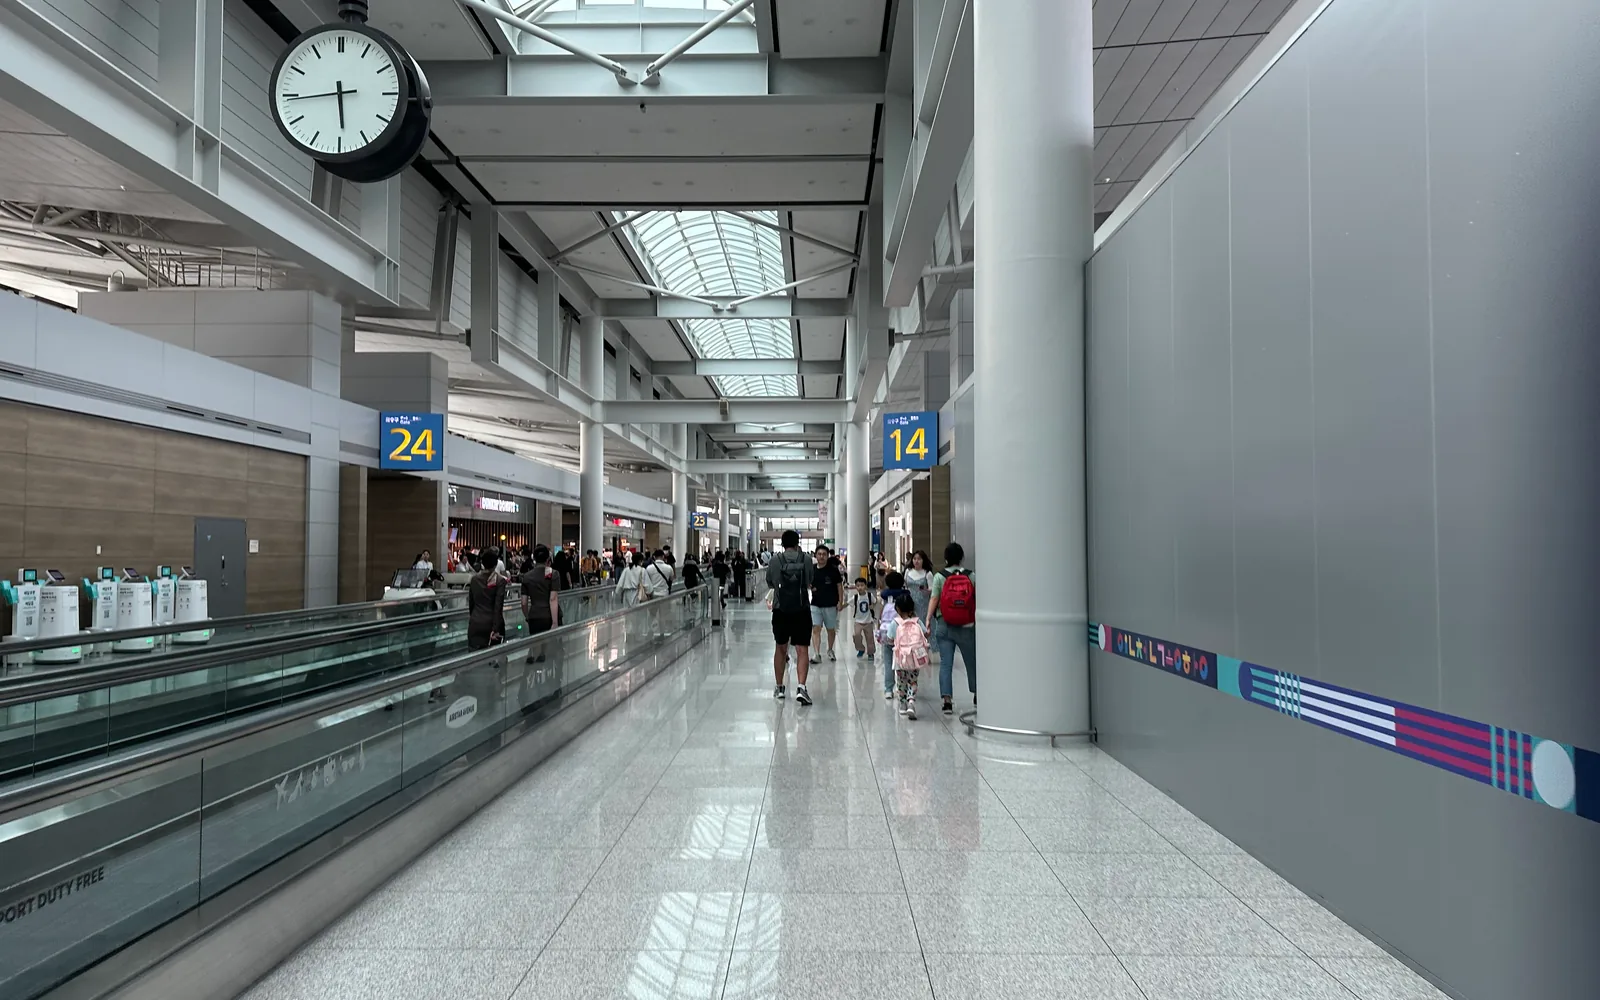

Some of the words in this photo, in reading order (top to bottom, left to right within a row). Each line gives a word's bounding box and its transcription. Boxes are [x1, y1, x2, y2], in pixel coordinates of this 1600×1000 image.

[389, 428, 436, 461] 24
[890, 428, 928, 461] 14
[694, 516, 705, 526] 23
[37, 879, 73, 909] DUTY
[76, 866, 104, 891] FREE
